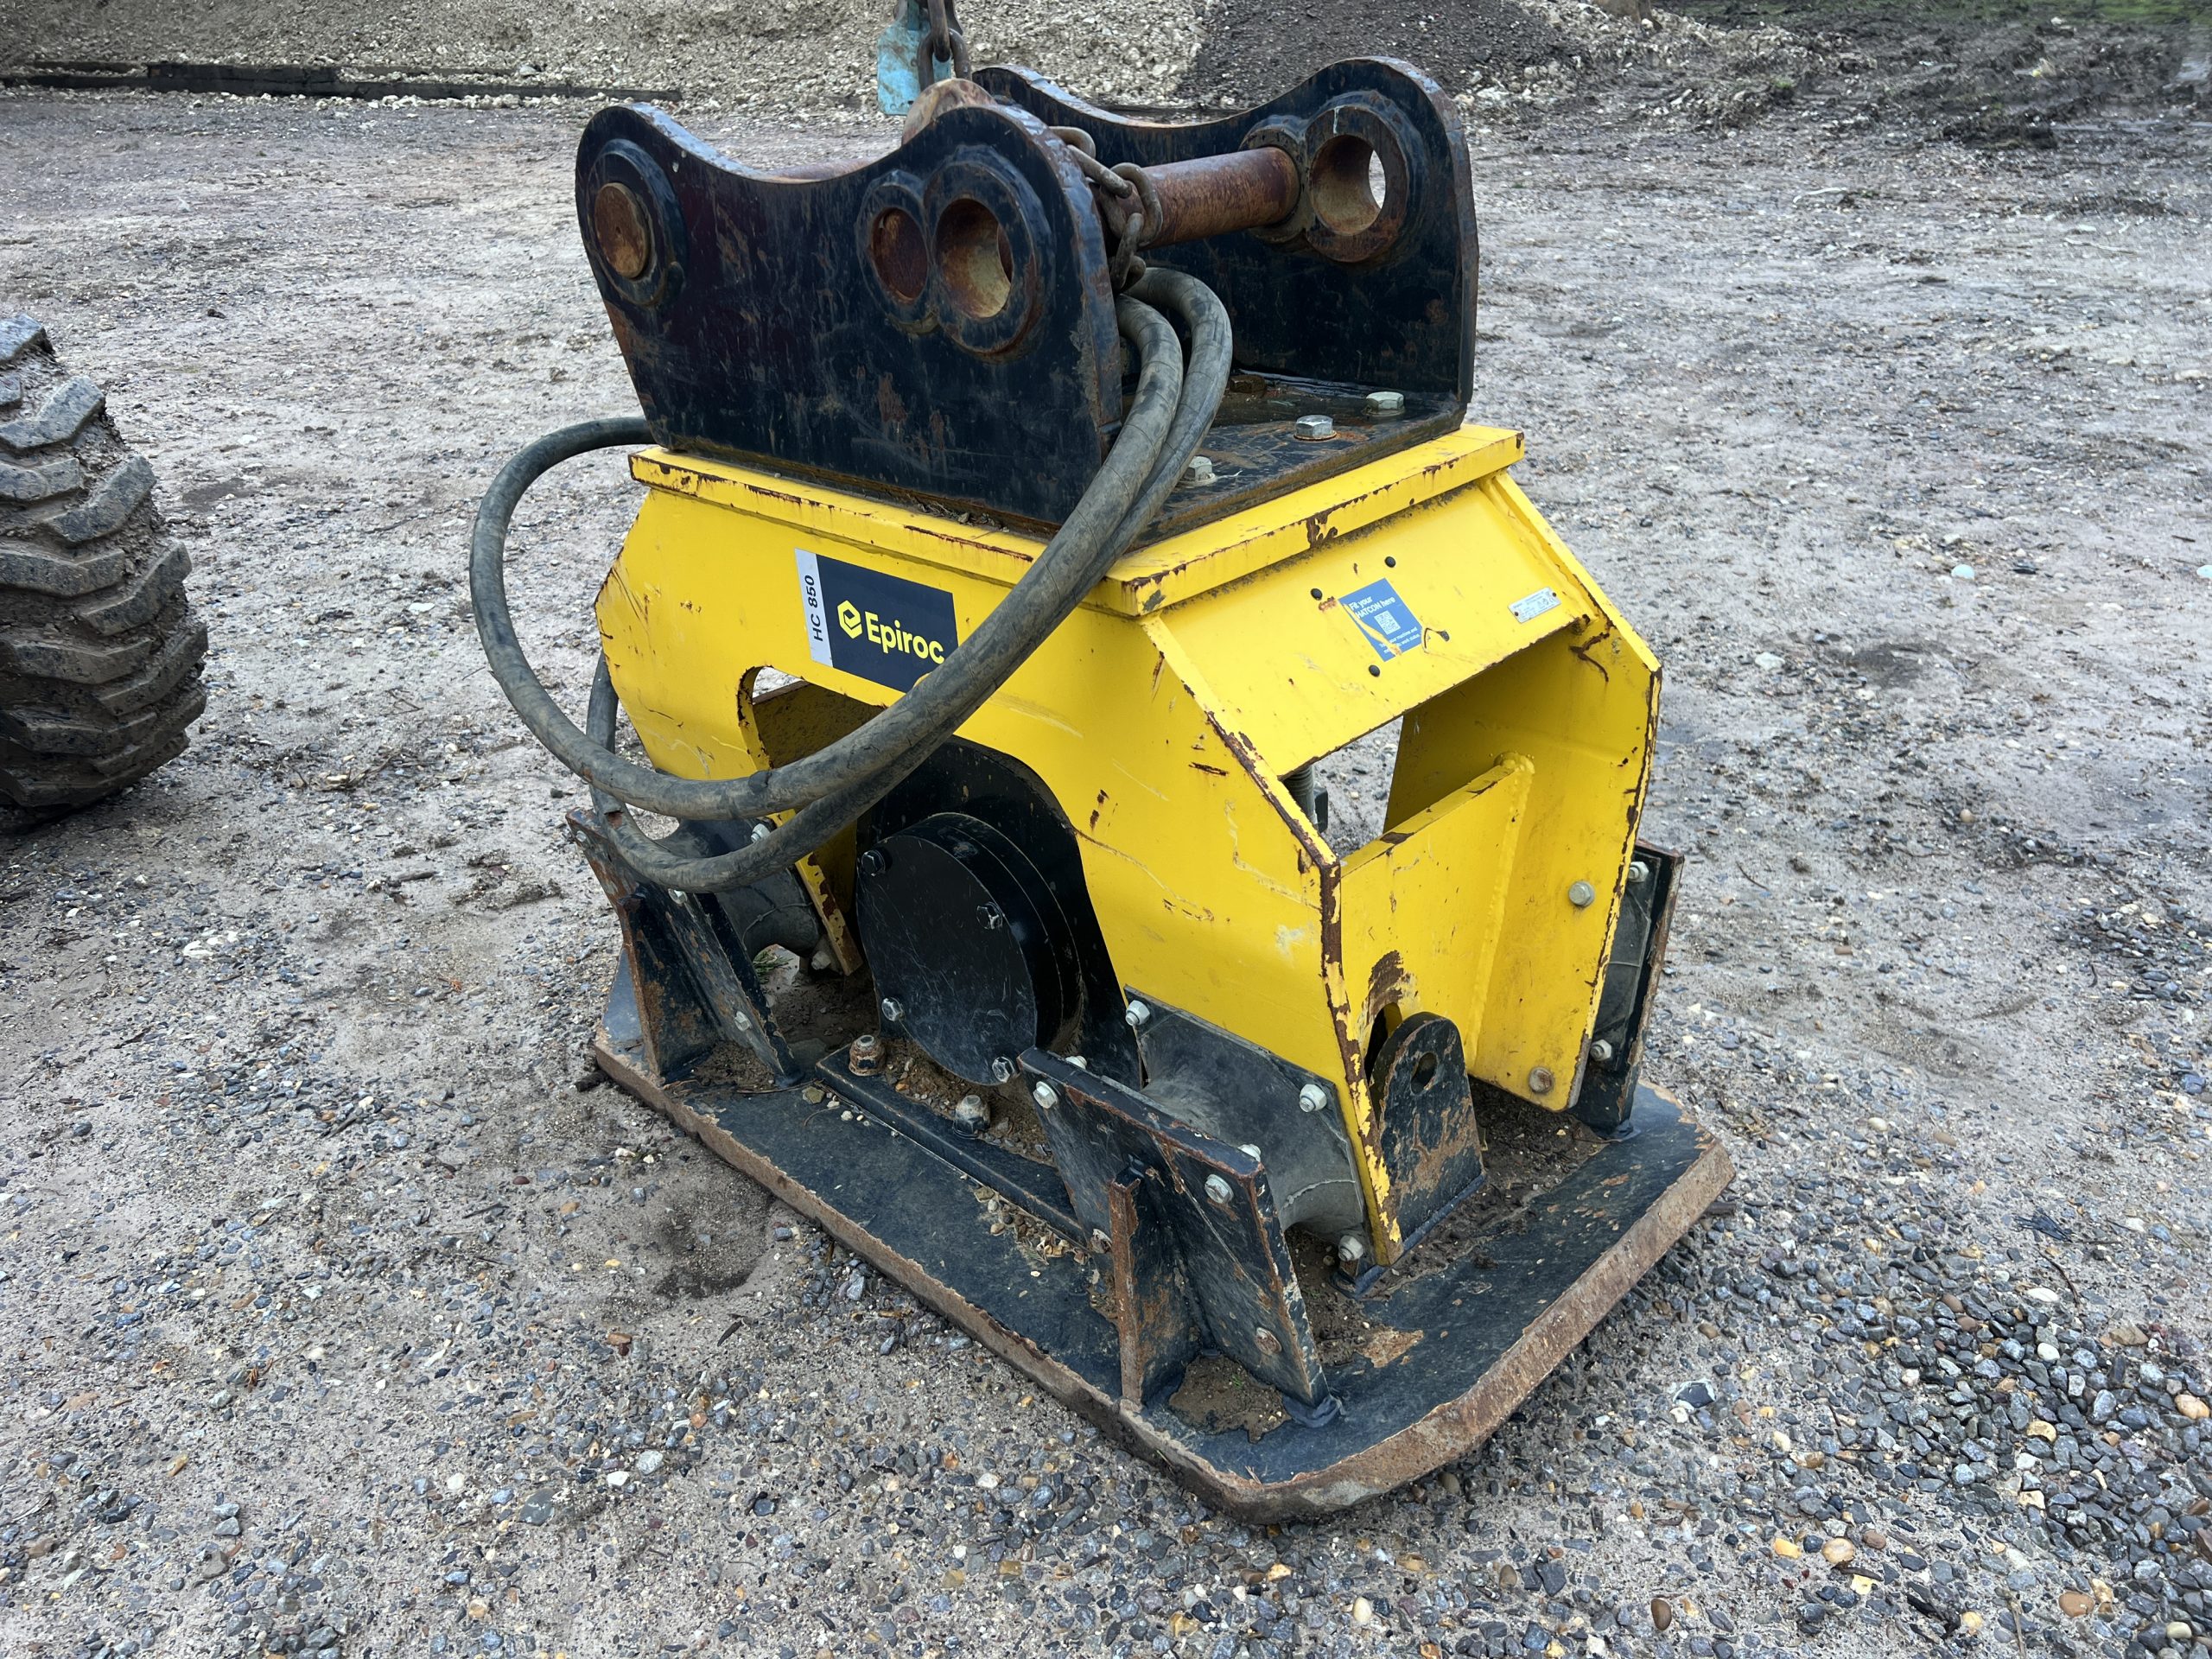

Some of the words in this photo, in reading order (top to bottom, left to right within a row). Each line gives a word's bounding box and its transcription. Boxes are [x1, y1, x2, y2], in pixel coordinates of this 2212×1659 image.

[804, 575, 818, 608] 850
[1348, 601, 1360, 611] Fit
[1358, 596, 1373, 607] your
[1379, 596, 1396, 607] here
[810, 613, 823, 641] HC
[864, 610, 945, 664] Epiroc
